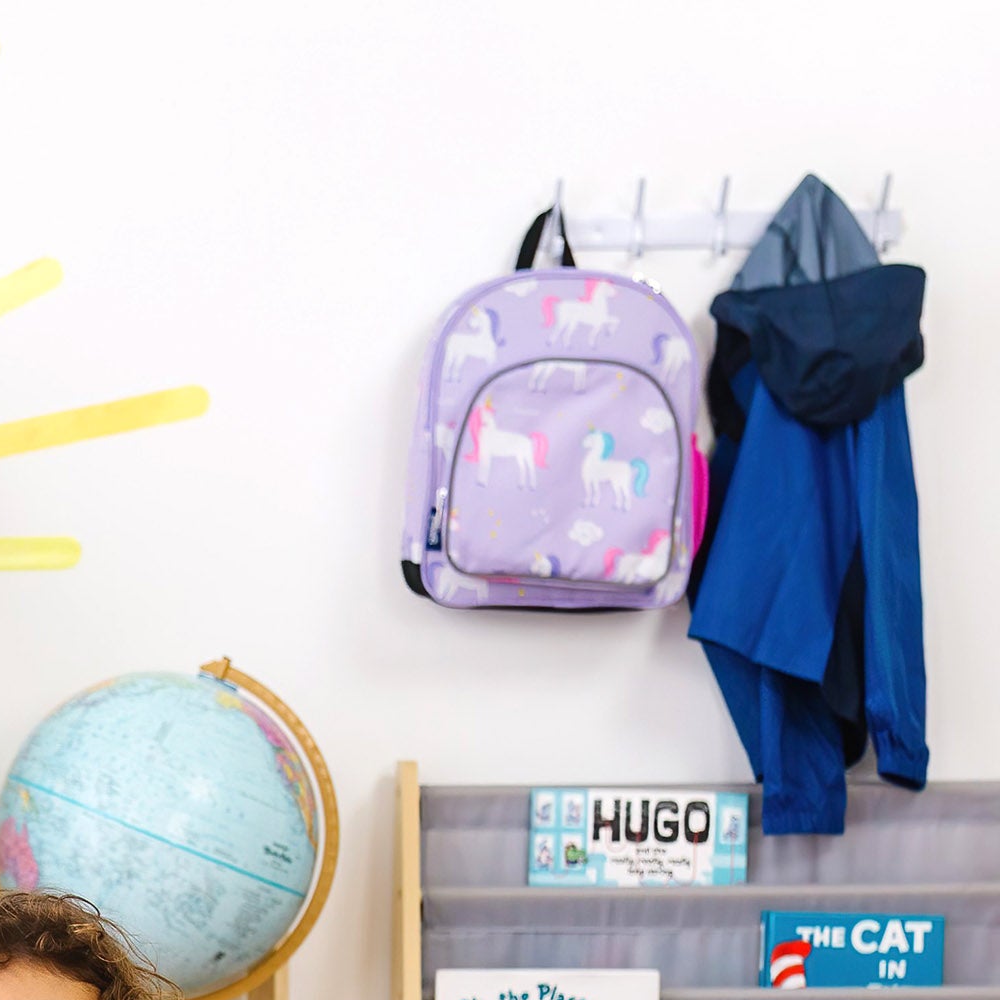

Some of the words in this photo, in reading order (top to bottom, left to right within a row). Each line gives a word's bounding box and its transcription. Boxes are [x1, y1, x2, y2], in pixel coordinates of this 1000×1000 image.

[592, 799, 711, 843] HUGO
[796, 925, 846, 948] THE
[851, 918, 933, 954] CAT
[878, 959, 907, 980] IN
